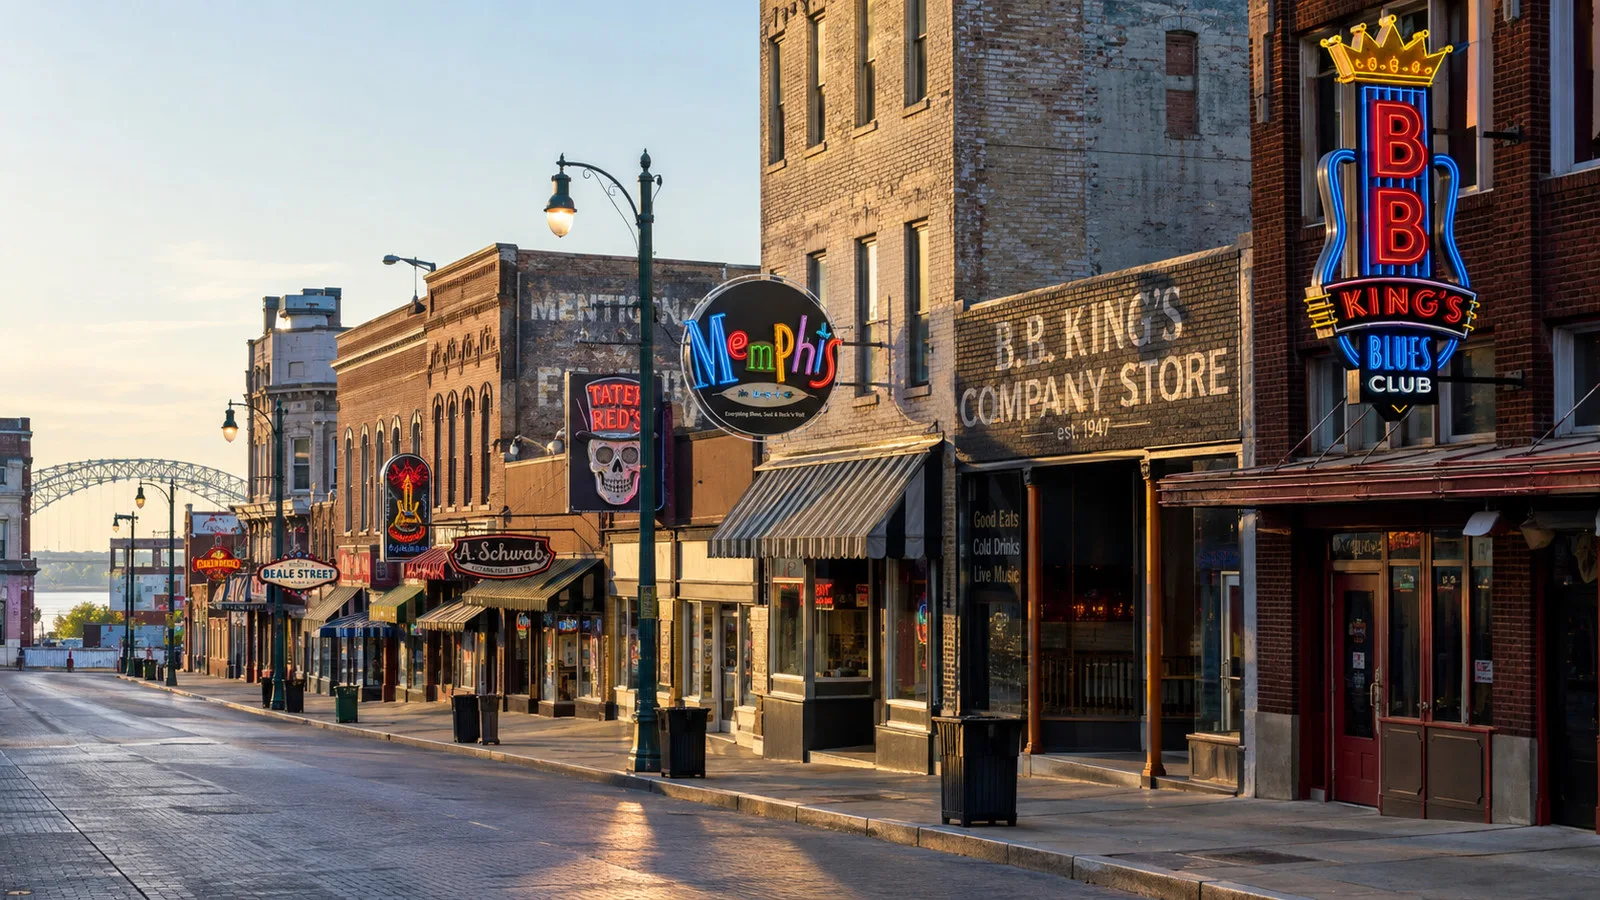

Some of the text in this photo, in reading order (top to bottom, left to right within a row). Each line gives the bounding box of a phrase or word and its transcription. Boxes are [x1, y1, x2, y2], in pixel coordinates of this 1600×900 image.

[1340, 286, 1463, 324] KING'S
[1064, 286, 1184, 359] KING'S
[683, 312, 843, 389] Memphis
[1368, 335, 1431, 371] BLUES
[960, 347, 1229, 428] COMPANY STORE
[1369, 375, 1432, 393] CLUB
[1057, 418, 1110, 441] est. 1947
[974, 509, 1019, 528] Good Eats
[454, 542, 476, 560] A.
[973, 536, 1020, 555] Cold Drinks
[263, 569, 334, 579] BEALE STREET
[974, 565, 1020, 583] Live Music
